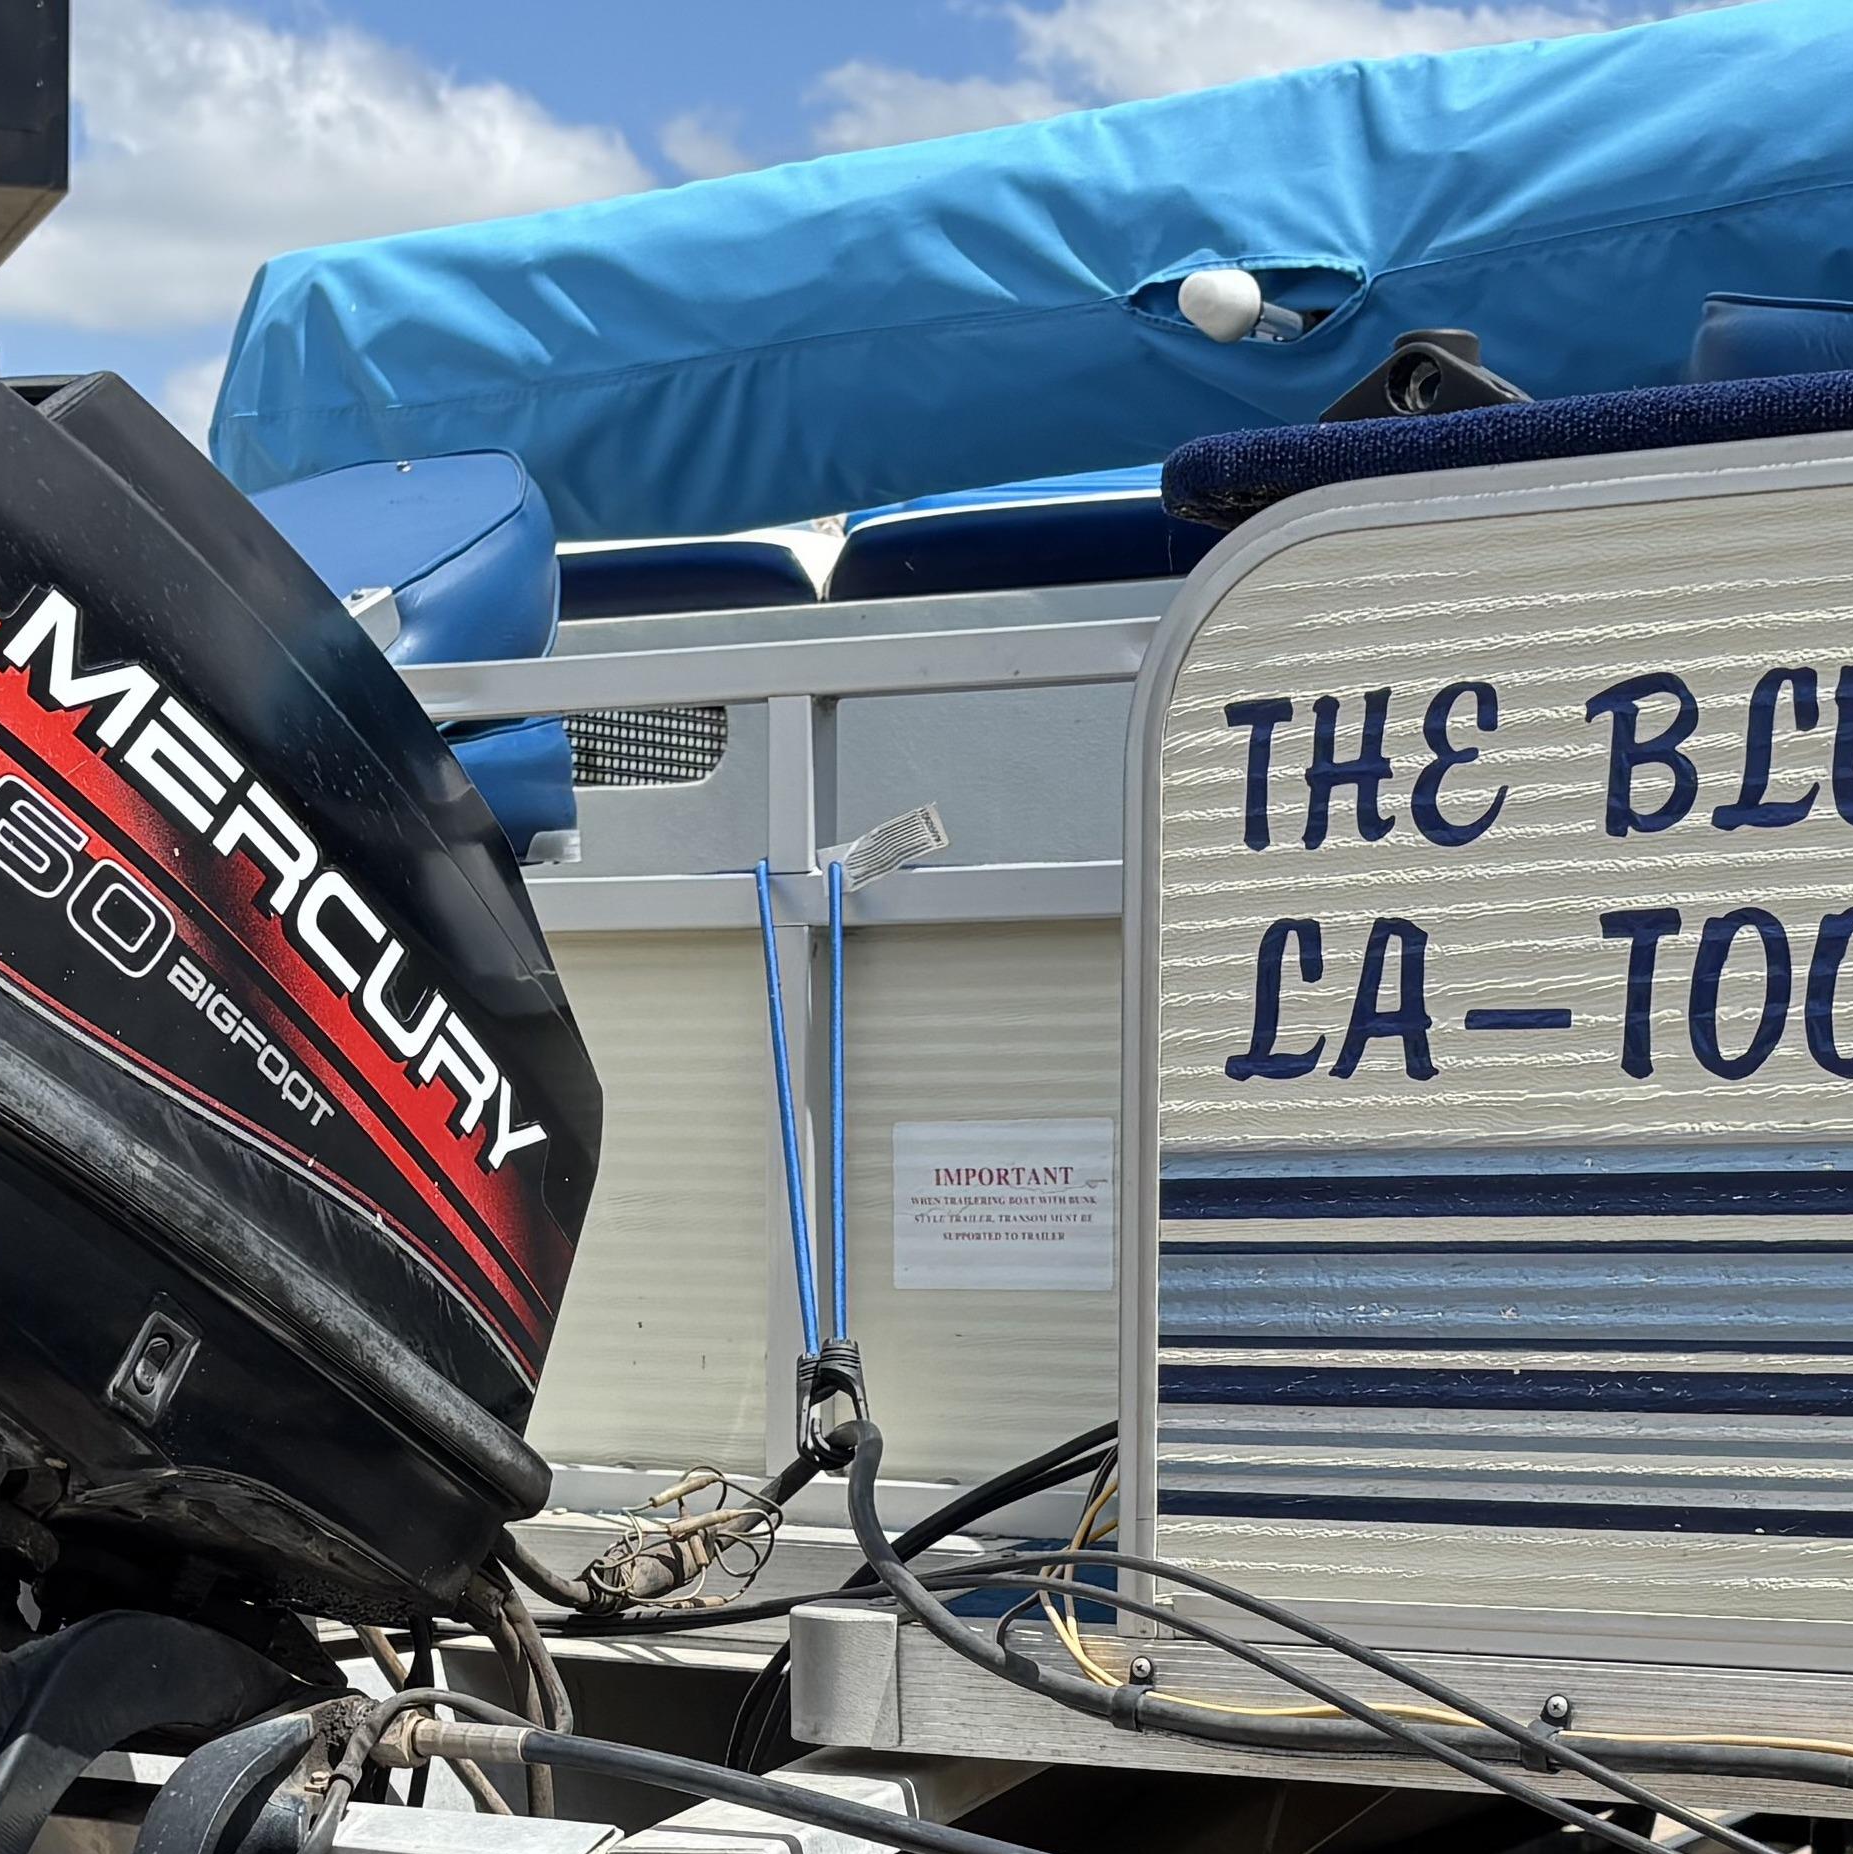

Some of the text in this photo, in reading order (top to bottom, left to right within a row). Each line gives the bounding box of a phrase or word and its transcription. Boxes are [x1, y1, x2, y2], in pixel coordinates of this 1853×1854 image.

[1223, 680, 1509, 852] THE
[4, 585, 547, 1172] MERCURY
[166, 954, 334, 1128] BIGFOOT
[933, 1165, 1074, 1187] IMPORTANT
[911, 1195, 1098, 1206] WHEN TRAILERING BOAT WITH BUNK
[913, 1213, 946, 1224] STYLE
[998, 1213, 1048, 1224] TRANSOM
[1049, 1213, 1080, 1223] MUST
[1080, 1213, 1093, 1223] BE
[942, 1230, 1066, 1241] SUPPORTED TO TRAILER
